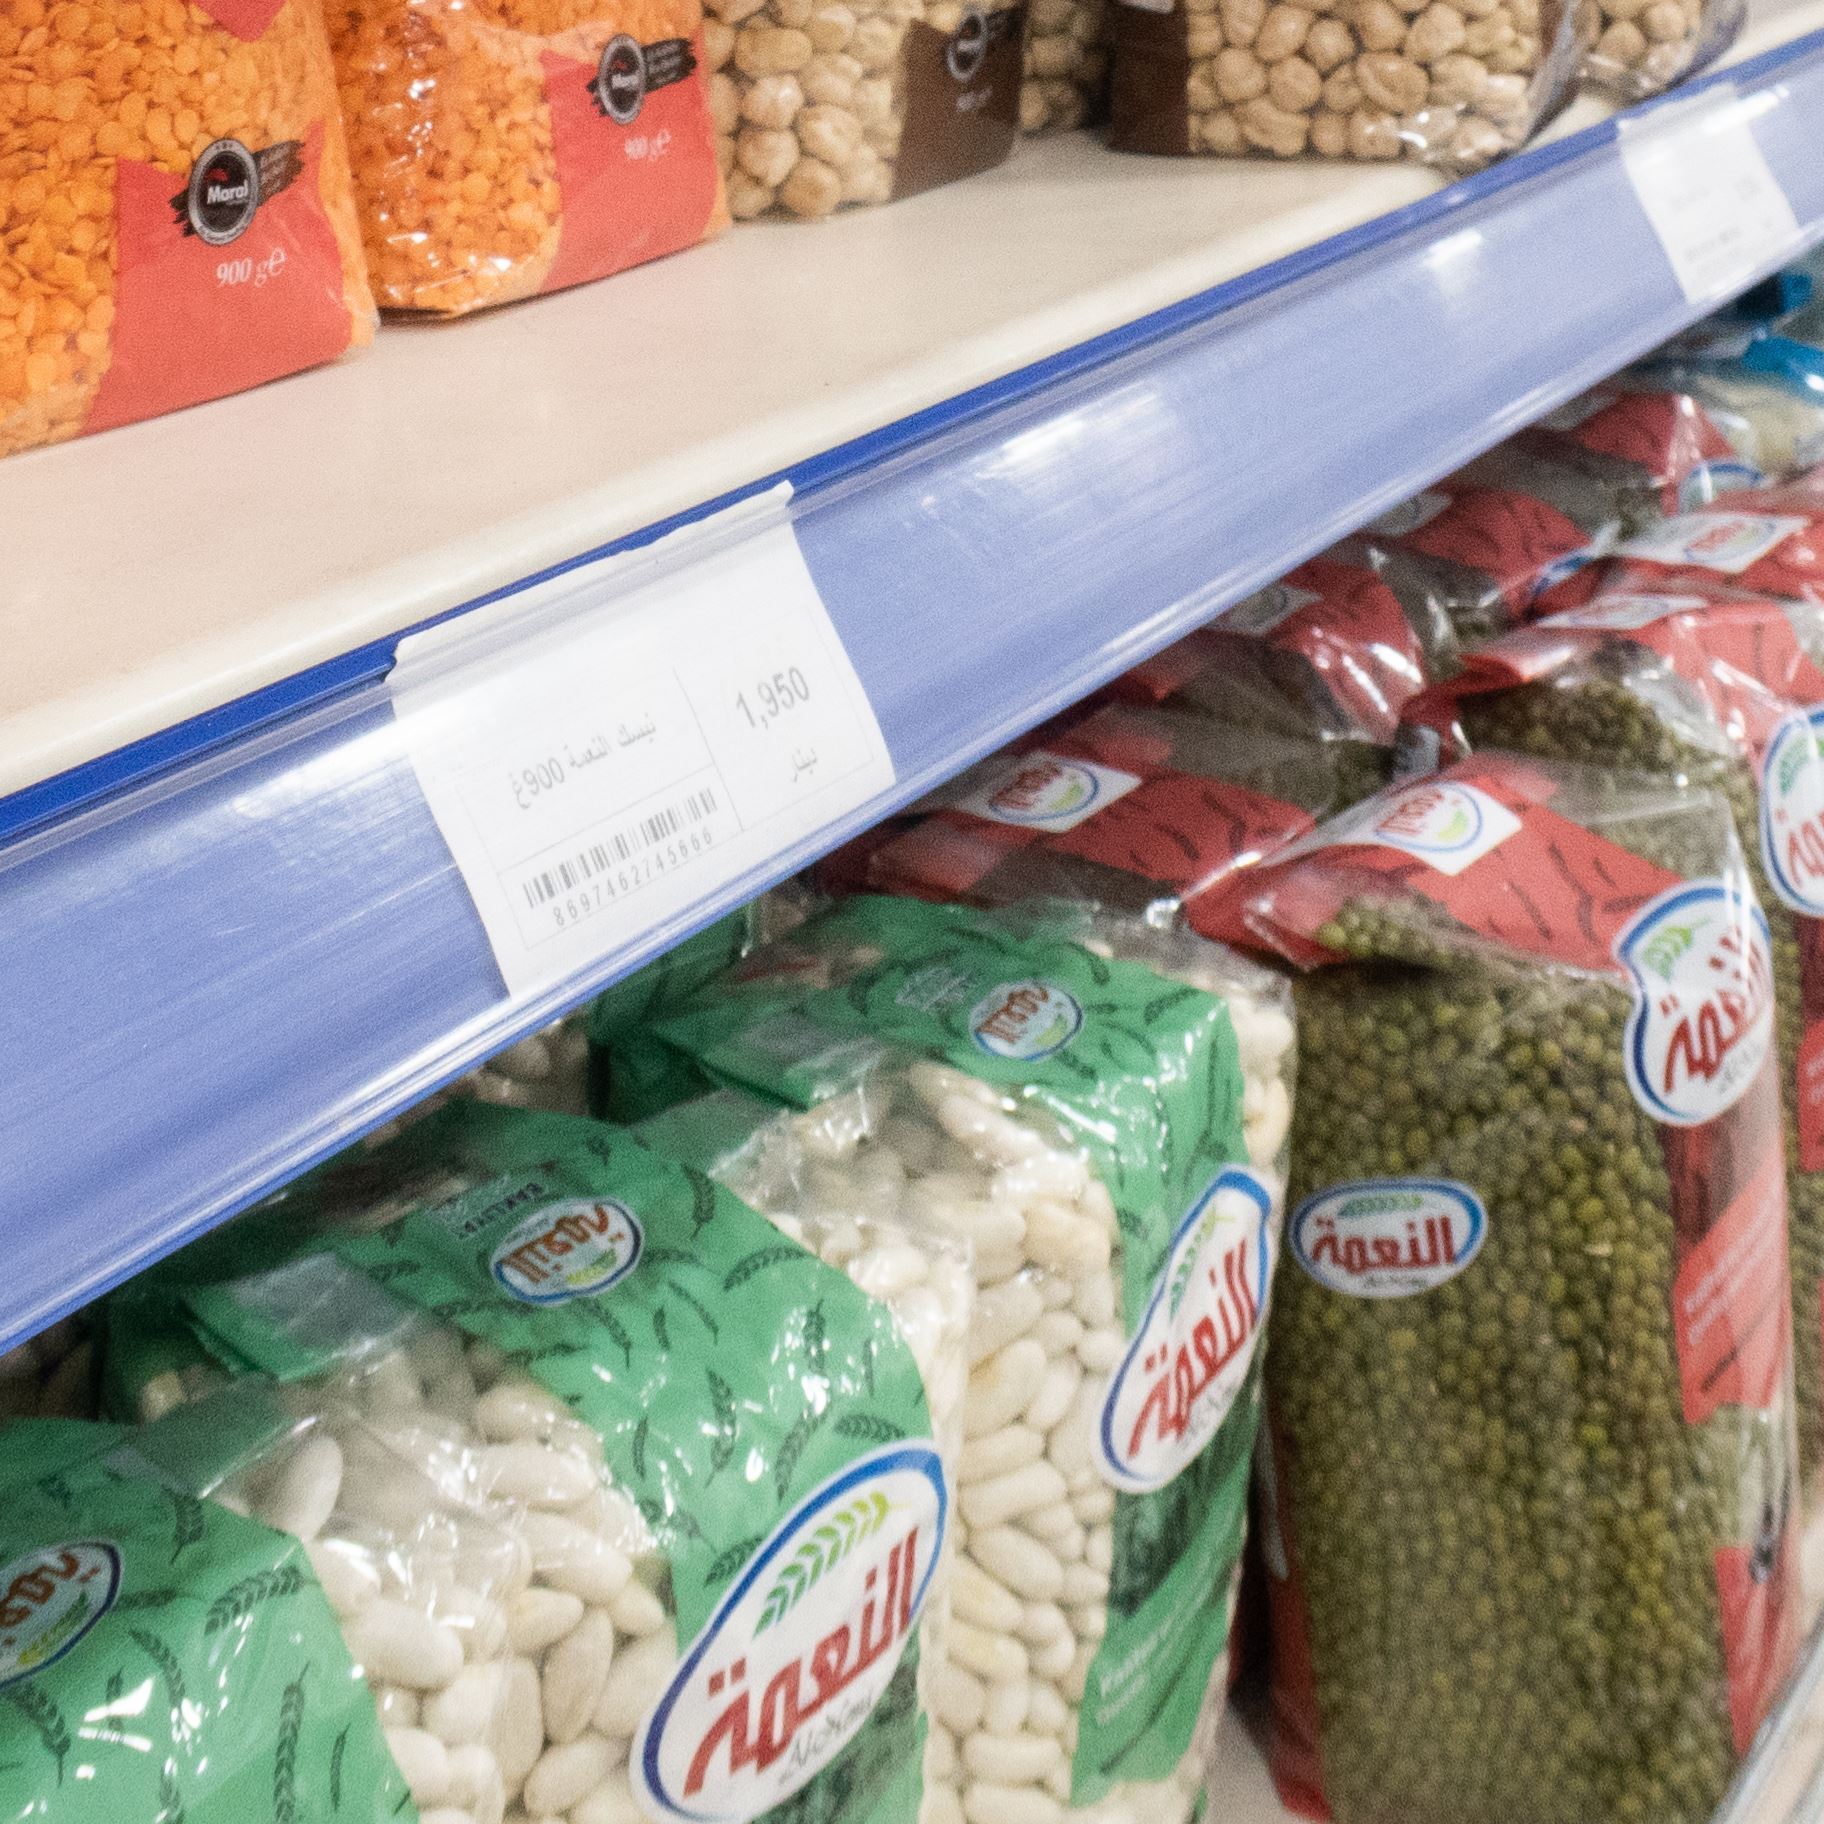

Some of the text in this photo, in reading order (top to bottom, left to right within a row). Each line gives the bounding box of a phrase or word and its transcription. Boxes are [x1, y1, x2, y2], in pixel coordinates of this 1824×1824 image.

[207, 179, 249, 206] Maral
[217, 257, 252, 287] 900
[735, 665, 810, 732] 1,950
[552, 827, 714, 927] 8697462745666
[1310, 1215, 1458, 1270] النعمة
[1127, 1237, 1258, 1459] النعمة
[683, 1526, 919, 1801] النعمة
